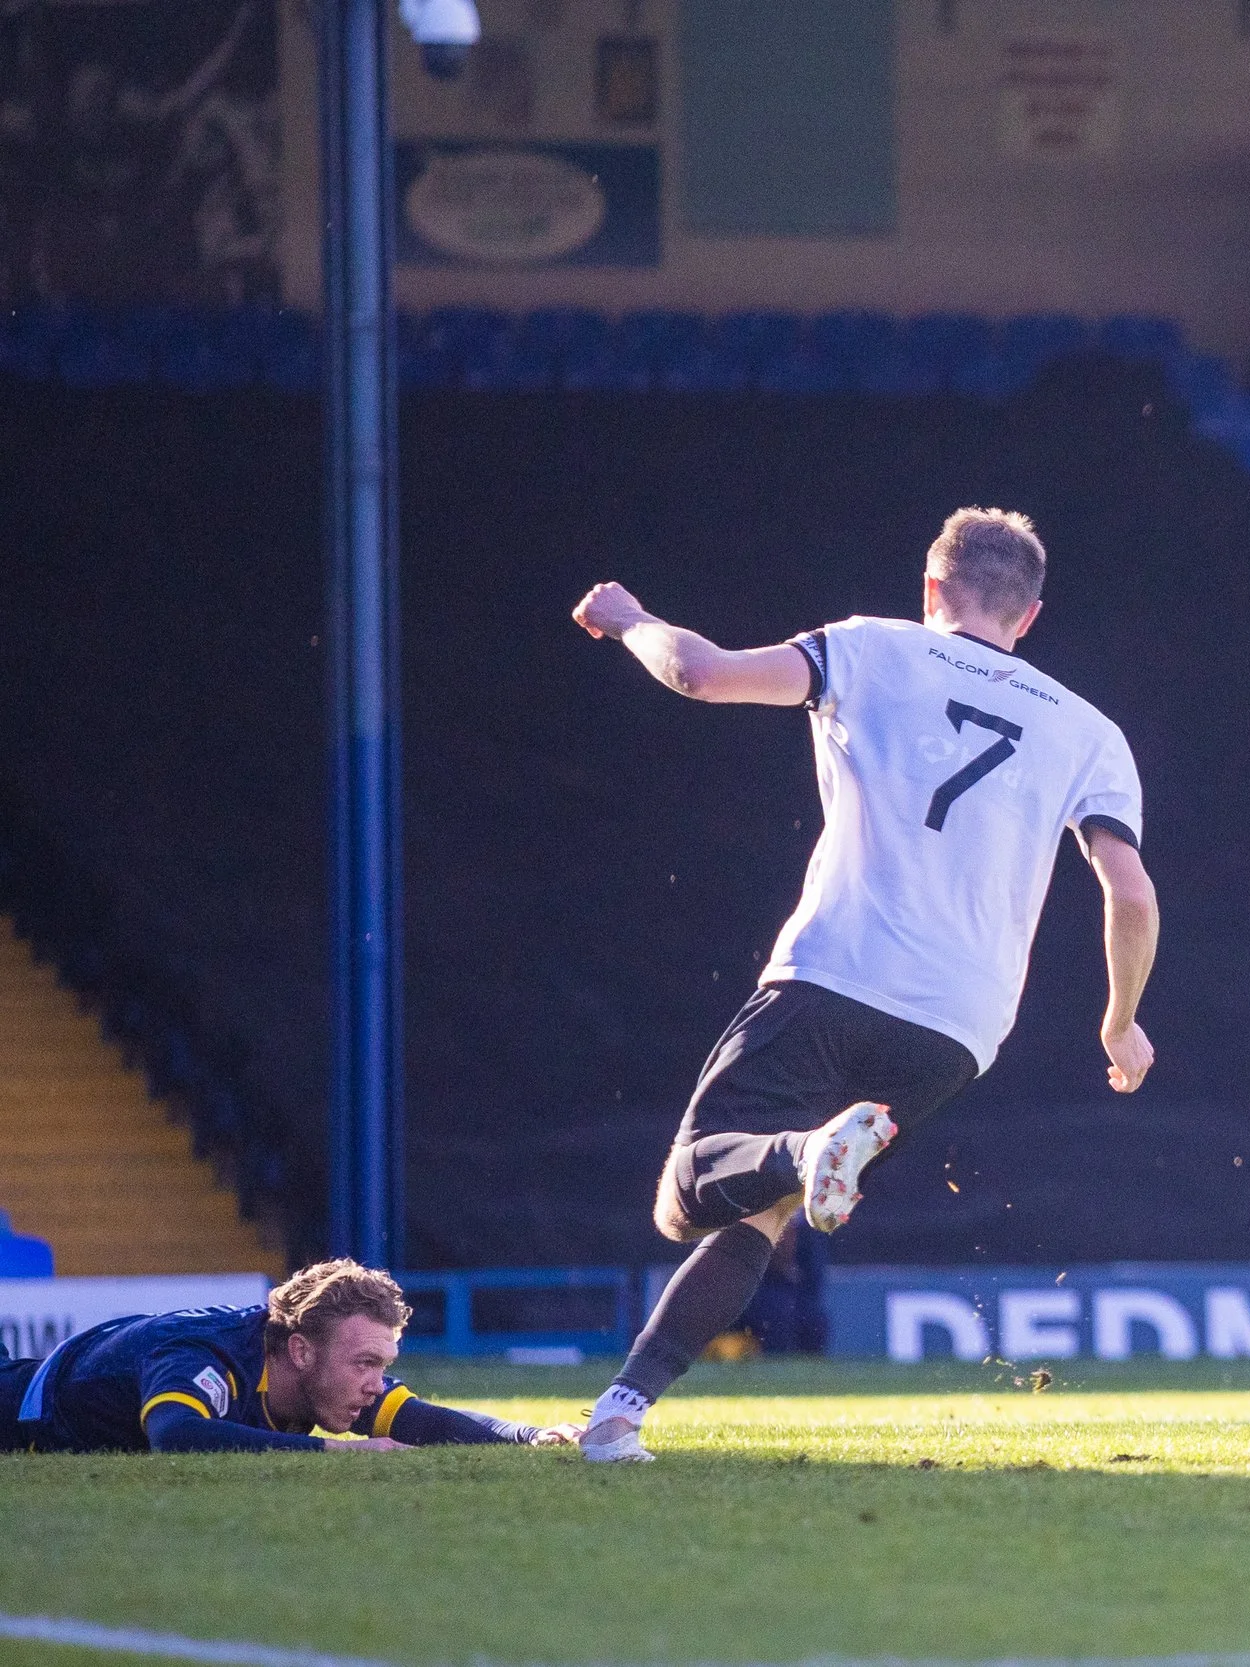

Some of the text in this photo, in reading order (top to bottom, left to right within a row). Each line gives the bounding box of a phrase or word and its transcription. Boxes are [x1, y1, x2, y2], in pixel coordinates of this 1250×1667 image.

[928, 648, 1059, 705] FALCON GREEN
[924, 698, 1023, 832] 7
